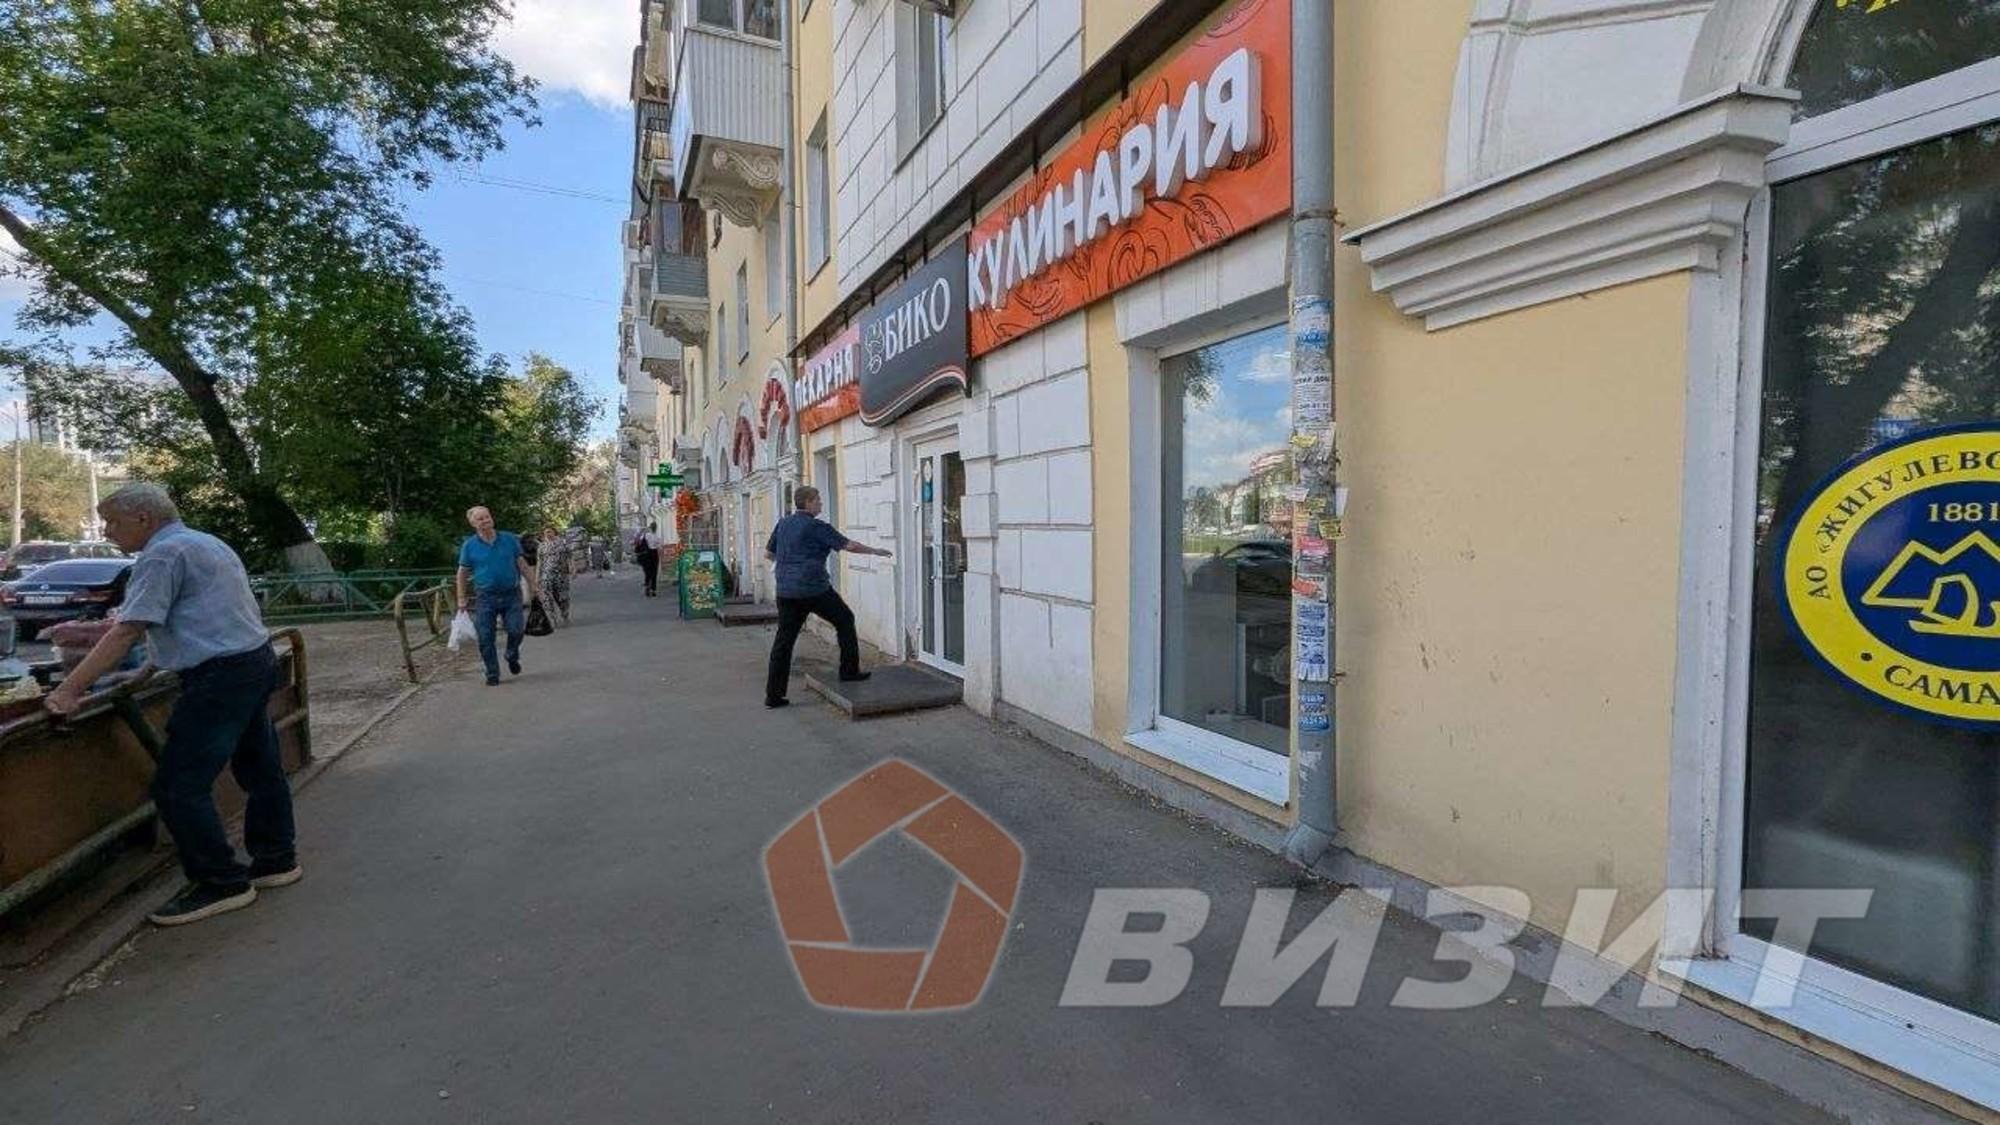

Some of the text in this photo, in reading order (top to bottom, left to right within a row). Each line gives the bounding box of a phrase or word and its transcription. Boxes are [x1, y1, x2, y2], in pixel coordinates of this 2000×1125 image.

[968, 48, 1250, 311] КУЛИНАРИЯ
[885, 278, 951, 361] БИКО
[794, 343, 854, 411] ПЕКАРНЯ
[1927, 502, 2000, 522] 1881
[1805, 565, 1831, 600] АО
[1884, 664, 2000, 705] САМА
